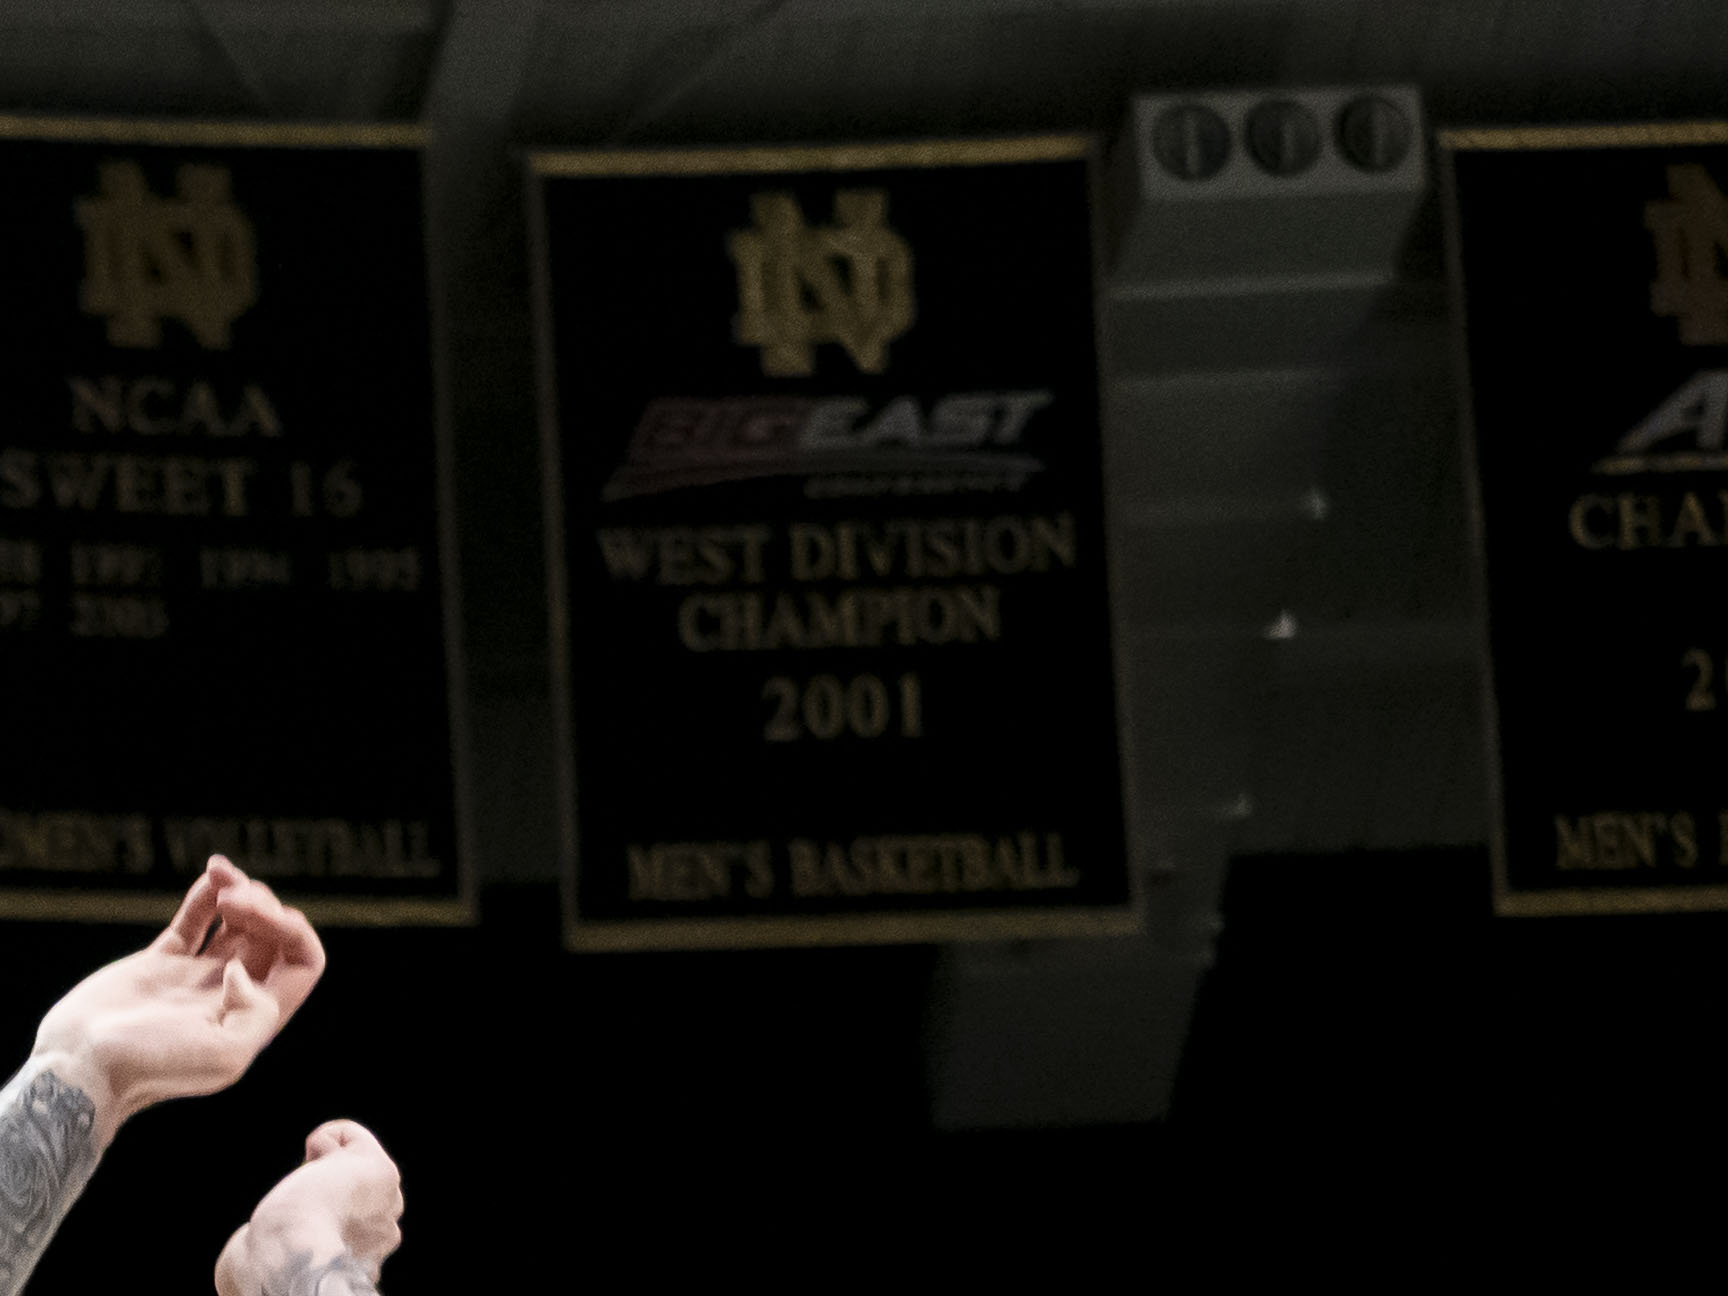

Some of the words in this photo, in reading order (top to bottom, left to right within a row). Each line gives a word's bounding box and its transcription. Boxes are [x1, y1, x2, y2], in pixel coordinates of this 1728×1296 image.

[68, 375, 282, 436] NCAA
[292, 459, 364, 518] 16
[598, 525, 771, 584] WEST
[791, 511, 1076, 582] DIVISION
[679, 587, 1001, 651] CHAMPION
[762, 673, 922, 742] 2001
[628, 840, 774, 900] MEN'S
[790, 830, 1080, 898] BASKETBALL
[1553, 810, 1699, 872] MEN'S
